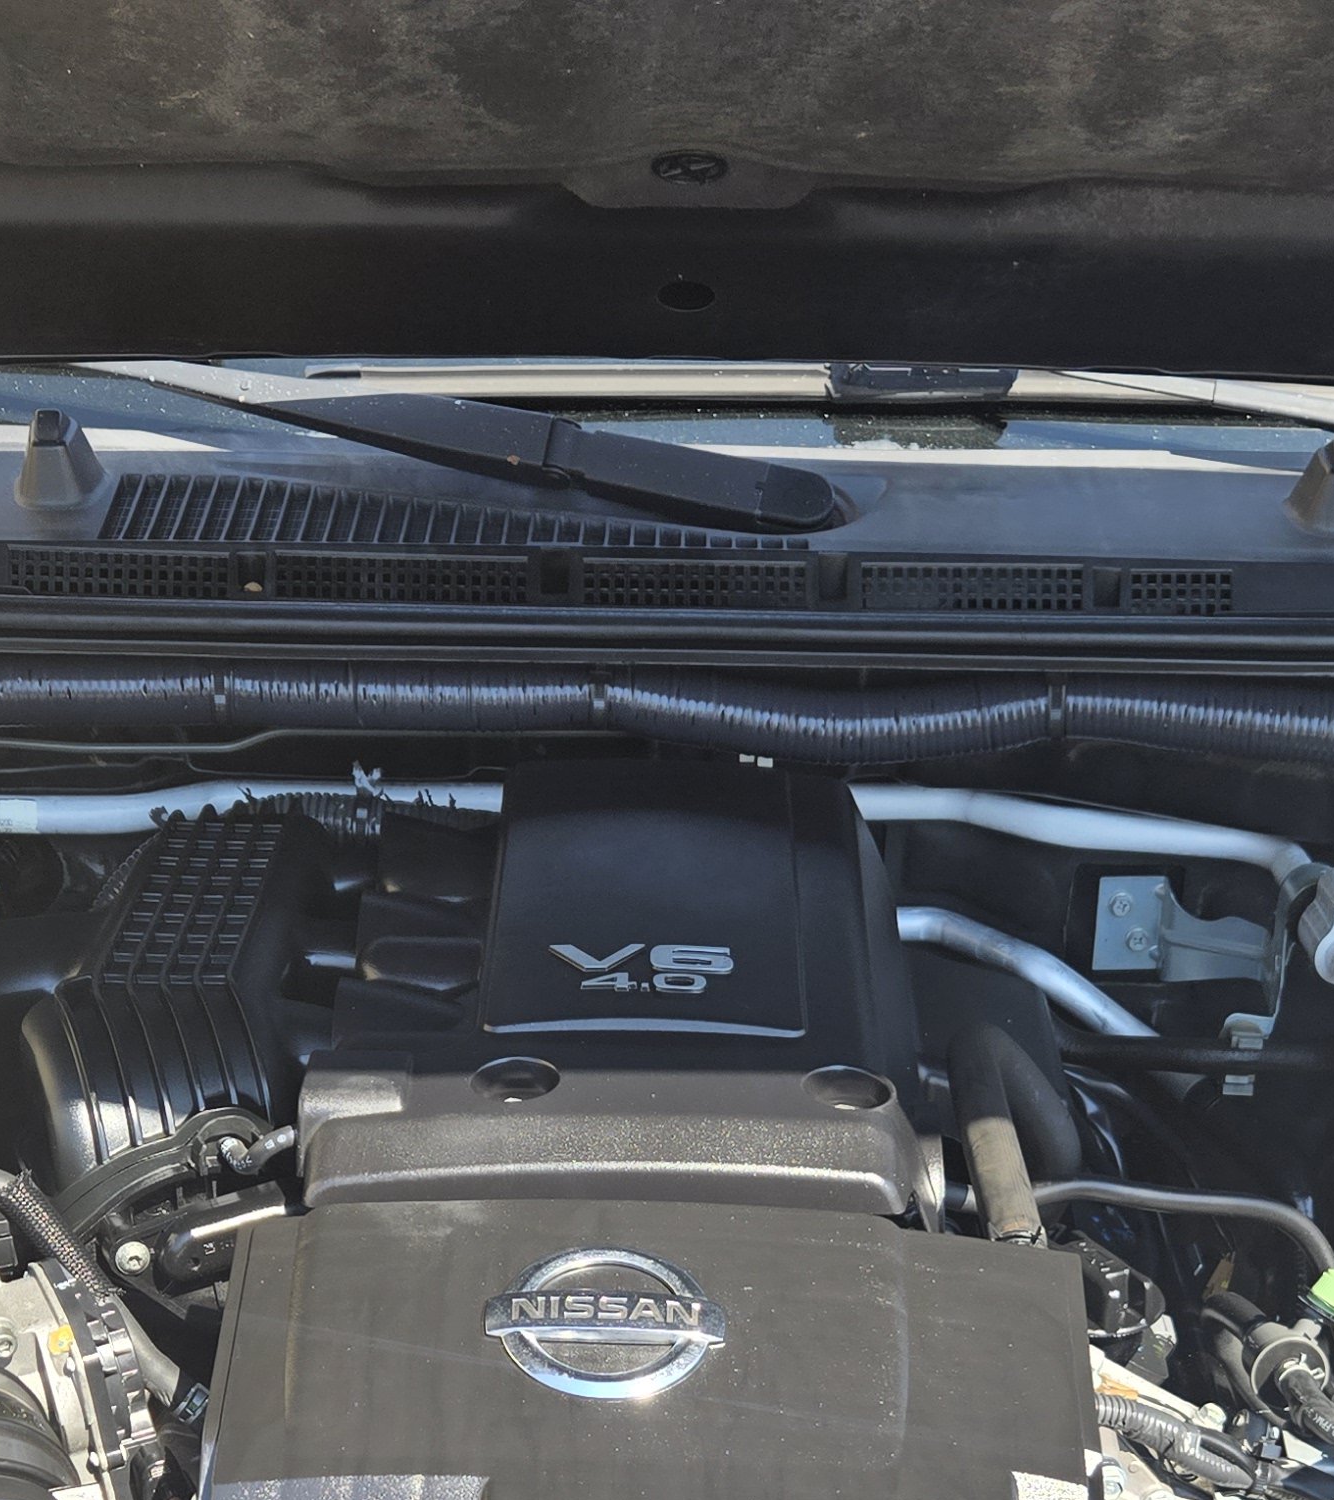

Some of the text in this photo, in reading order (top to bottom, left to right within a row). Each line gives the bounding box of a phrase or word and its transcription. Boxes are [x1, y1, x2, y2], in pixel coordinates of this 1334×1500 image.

[548, 943, 734, 975] V6
[580, 972, 707, 993] 4.0
[511, 1295, 701, 1327] NISSAN
